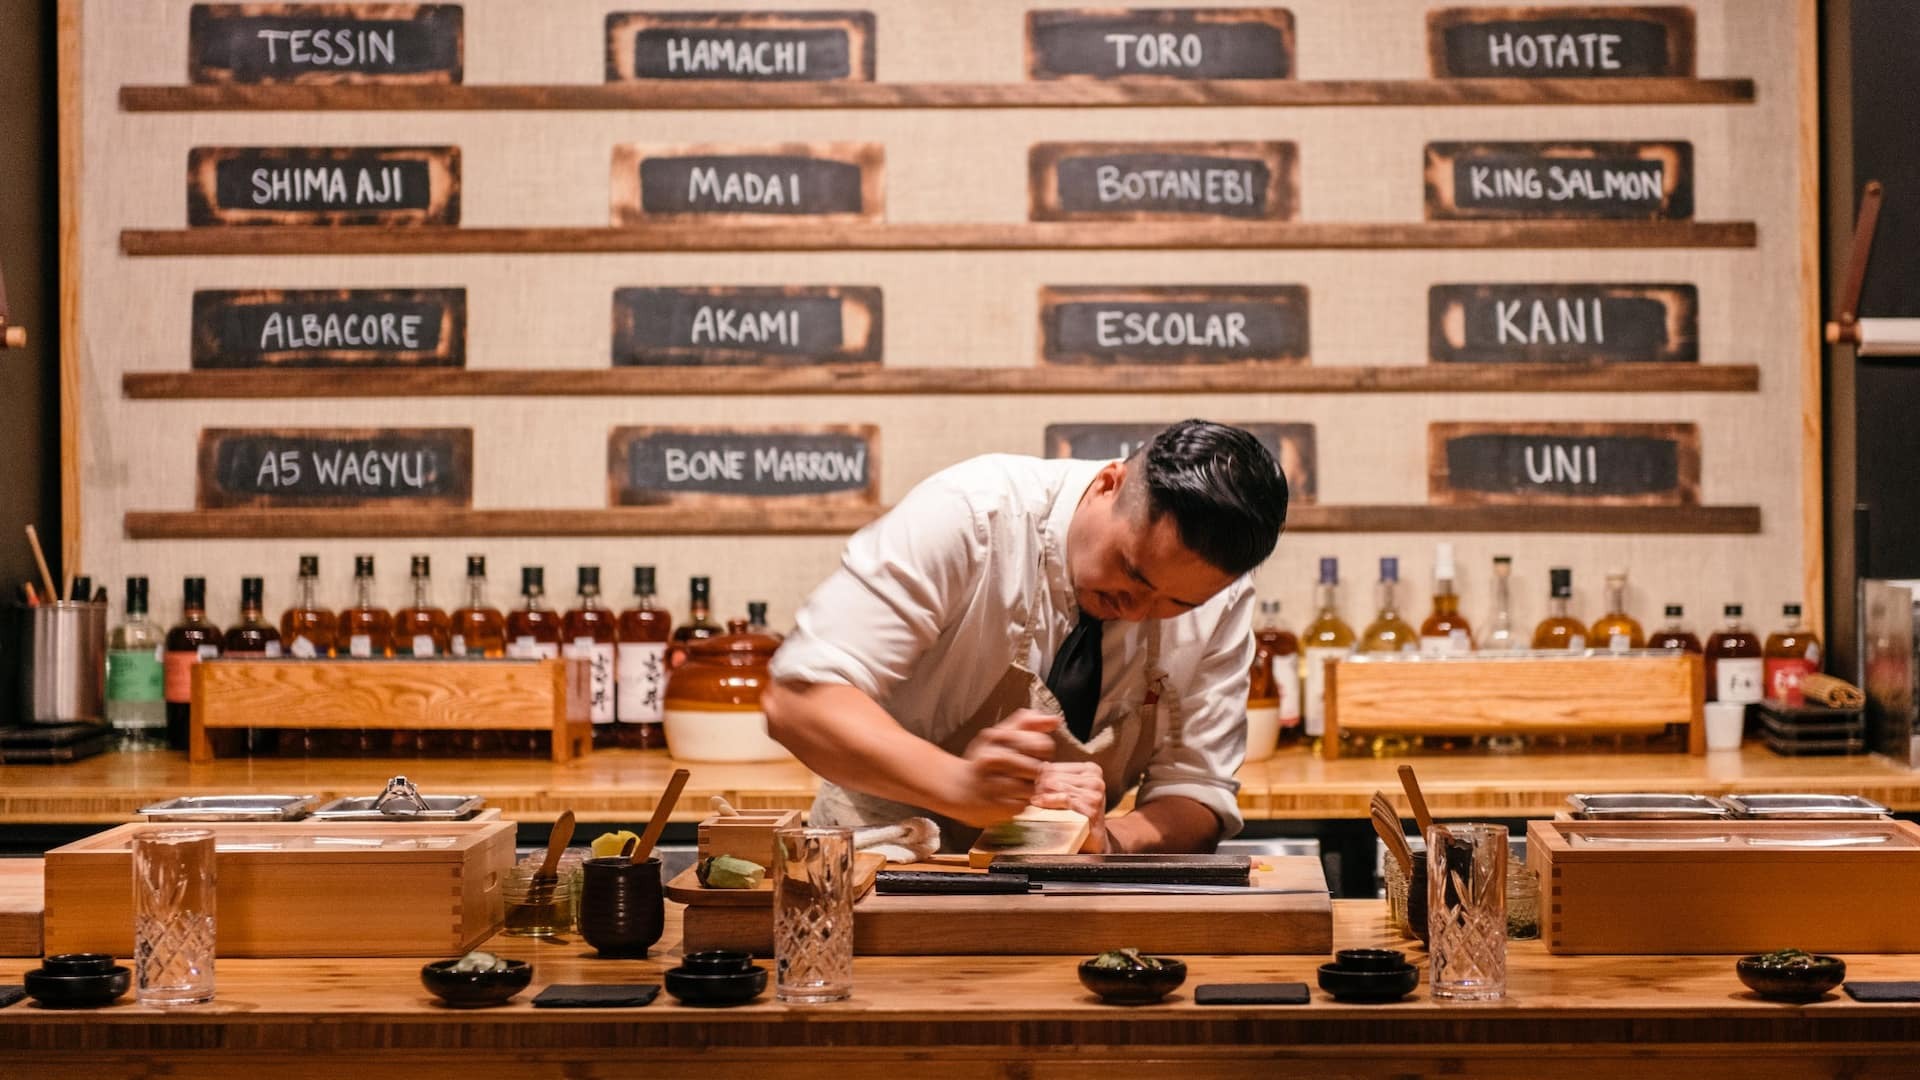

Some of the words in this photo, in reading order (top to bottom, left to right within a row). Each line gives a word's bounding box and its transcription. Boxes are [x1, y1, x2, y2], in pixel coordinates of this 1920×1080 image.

[257, 30, 396, 65] TESSIN
[666, 38, 807, 75] HAMACHI
[1106, 33, 1202, 68] TORO
[1489, 33, 1622, 70] HOTATE
[251, 168, 348, 205] SHIMA
[355, 167, 403, 204] AJI
[688, 166, 801, 206] MADAI
[1470, 166, 1544, 200] KING
[1546, 168, 1663, 201] SALMON
[260, 312, 423, 349] ALBACORE
[690, 306, 800, 346] AKAMI
[1096, 312, 1250, 348] ESCOLAR
[1496, 298, 1605, 345] KANI
[257, 451, 301, 487] A5
[312, 449, 425, 488] WAGYU
[664, 449, 746, 483] BONE
[753, 447, 865, 484] MARROW
[1525, 444, 1598, 485] UNI
